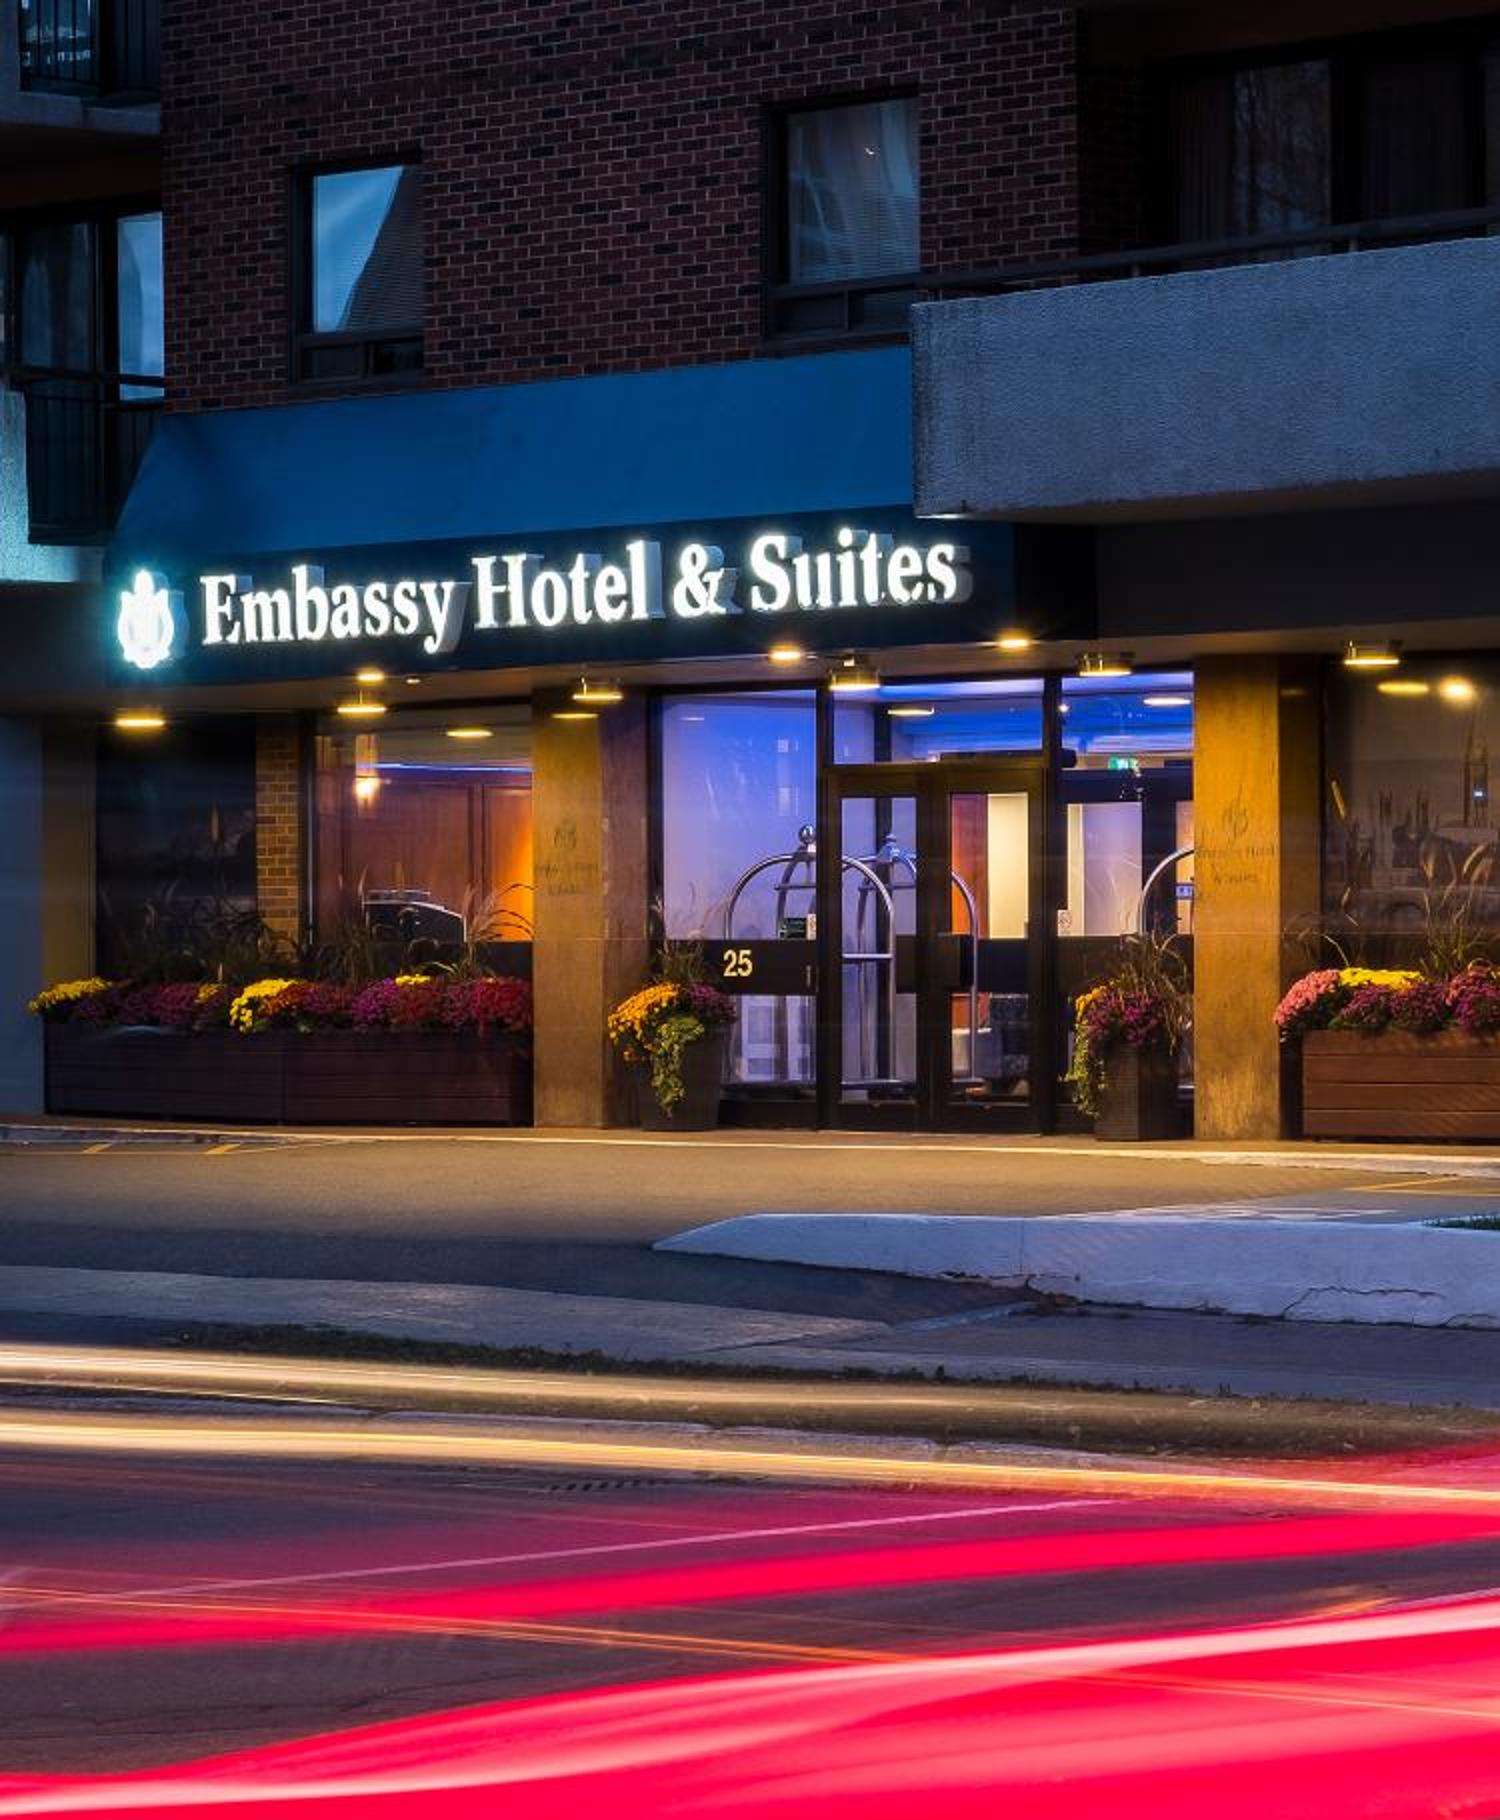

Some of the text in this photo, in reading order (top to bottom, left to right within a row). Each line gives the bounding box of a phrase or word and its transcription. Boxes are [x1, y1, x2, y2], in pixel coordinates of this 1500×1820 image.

[199, 525, 962, 655] Embassy Hotel & Suites
[722, 948, 754, 978] 25
